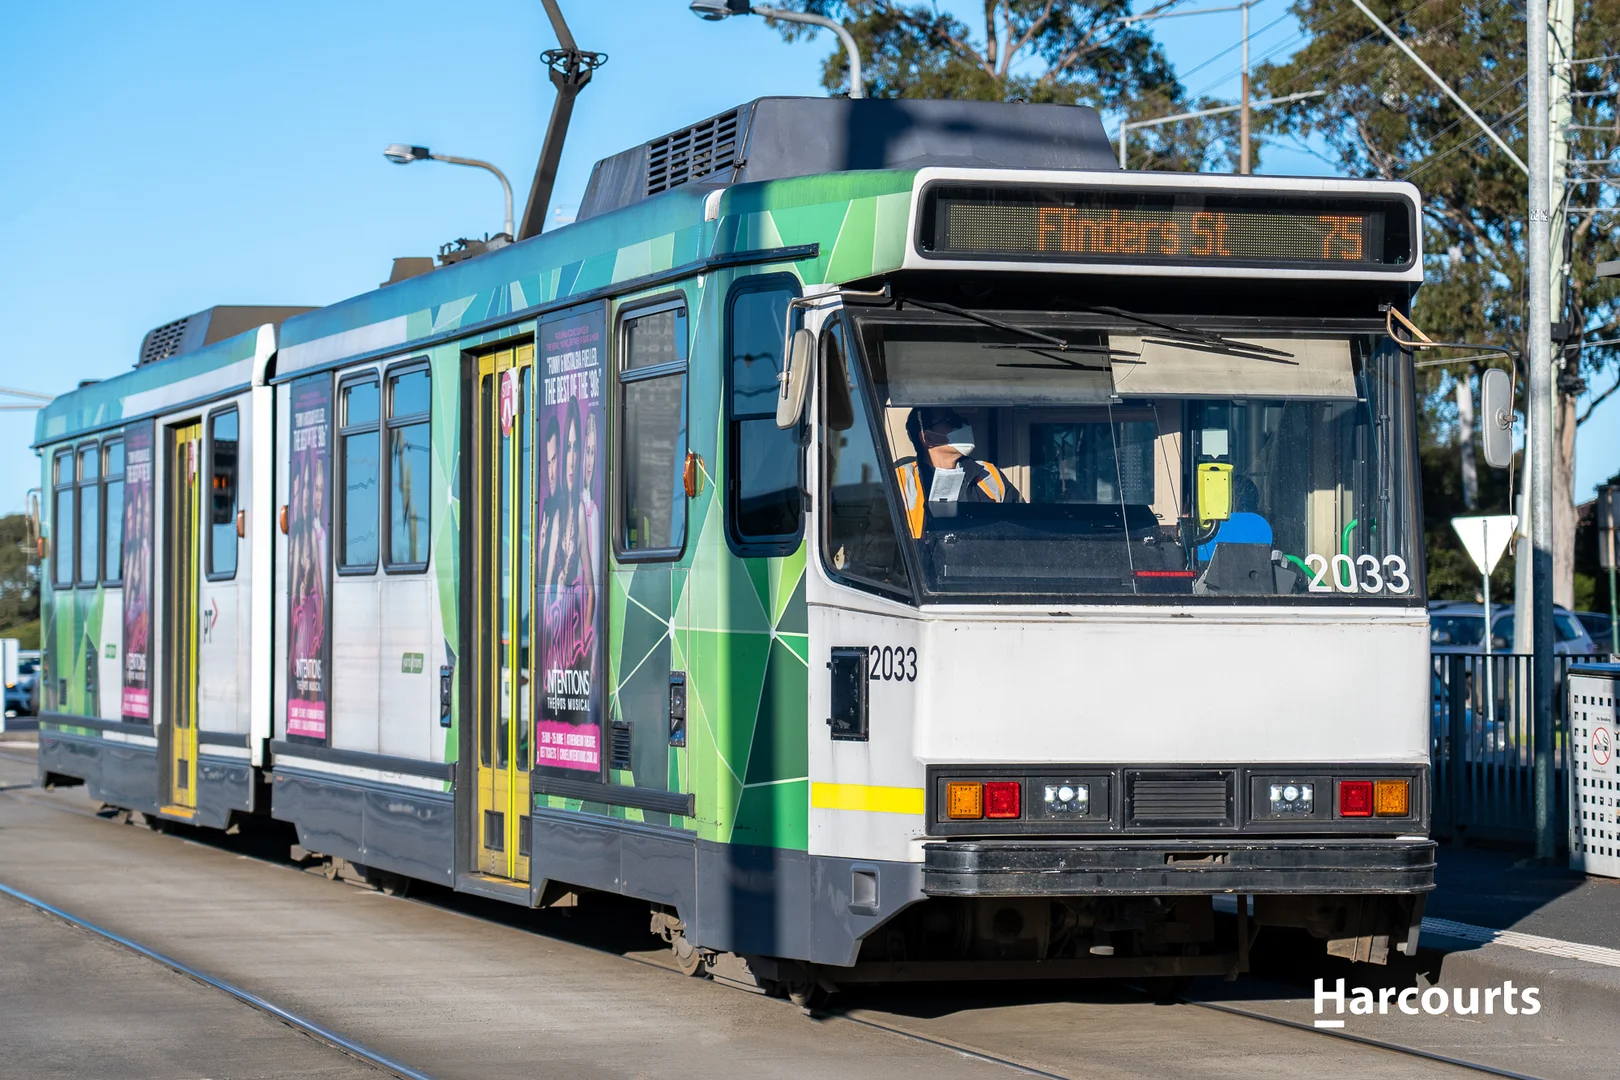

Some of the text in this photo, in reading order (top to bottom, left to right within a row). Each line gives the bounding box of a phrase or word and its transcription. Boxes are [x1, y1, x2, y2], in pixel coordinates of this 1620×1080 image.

[1039, 207, 1230, 256] Flinders St
[1319, 215, 1363, 260] 75
[545, 378, 556, 406] THE
[557, 374, 570, 404] BEST
[578, 371, 588, 401] THE
[1304, 553, 1410, 593] 2033
[547, 665, 590, 697] INTENTIONS
[869, 645, 918, 683] 2033
[547, 697, 556, 709] THE
[567, 698, 590, 711] MUSICAL
